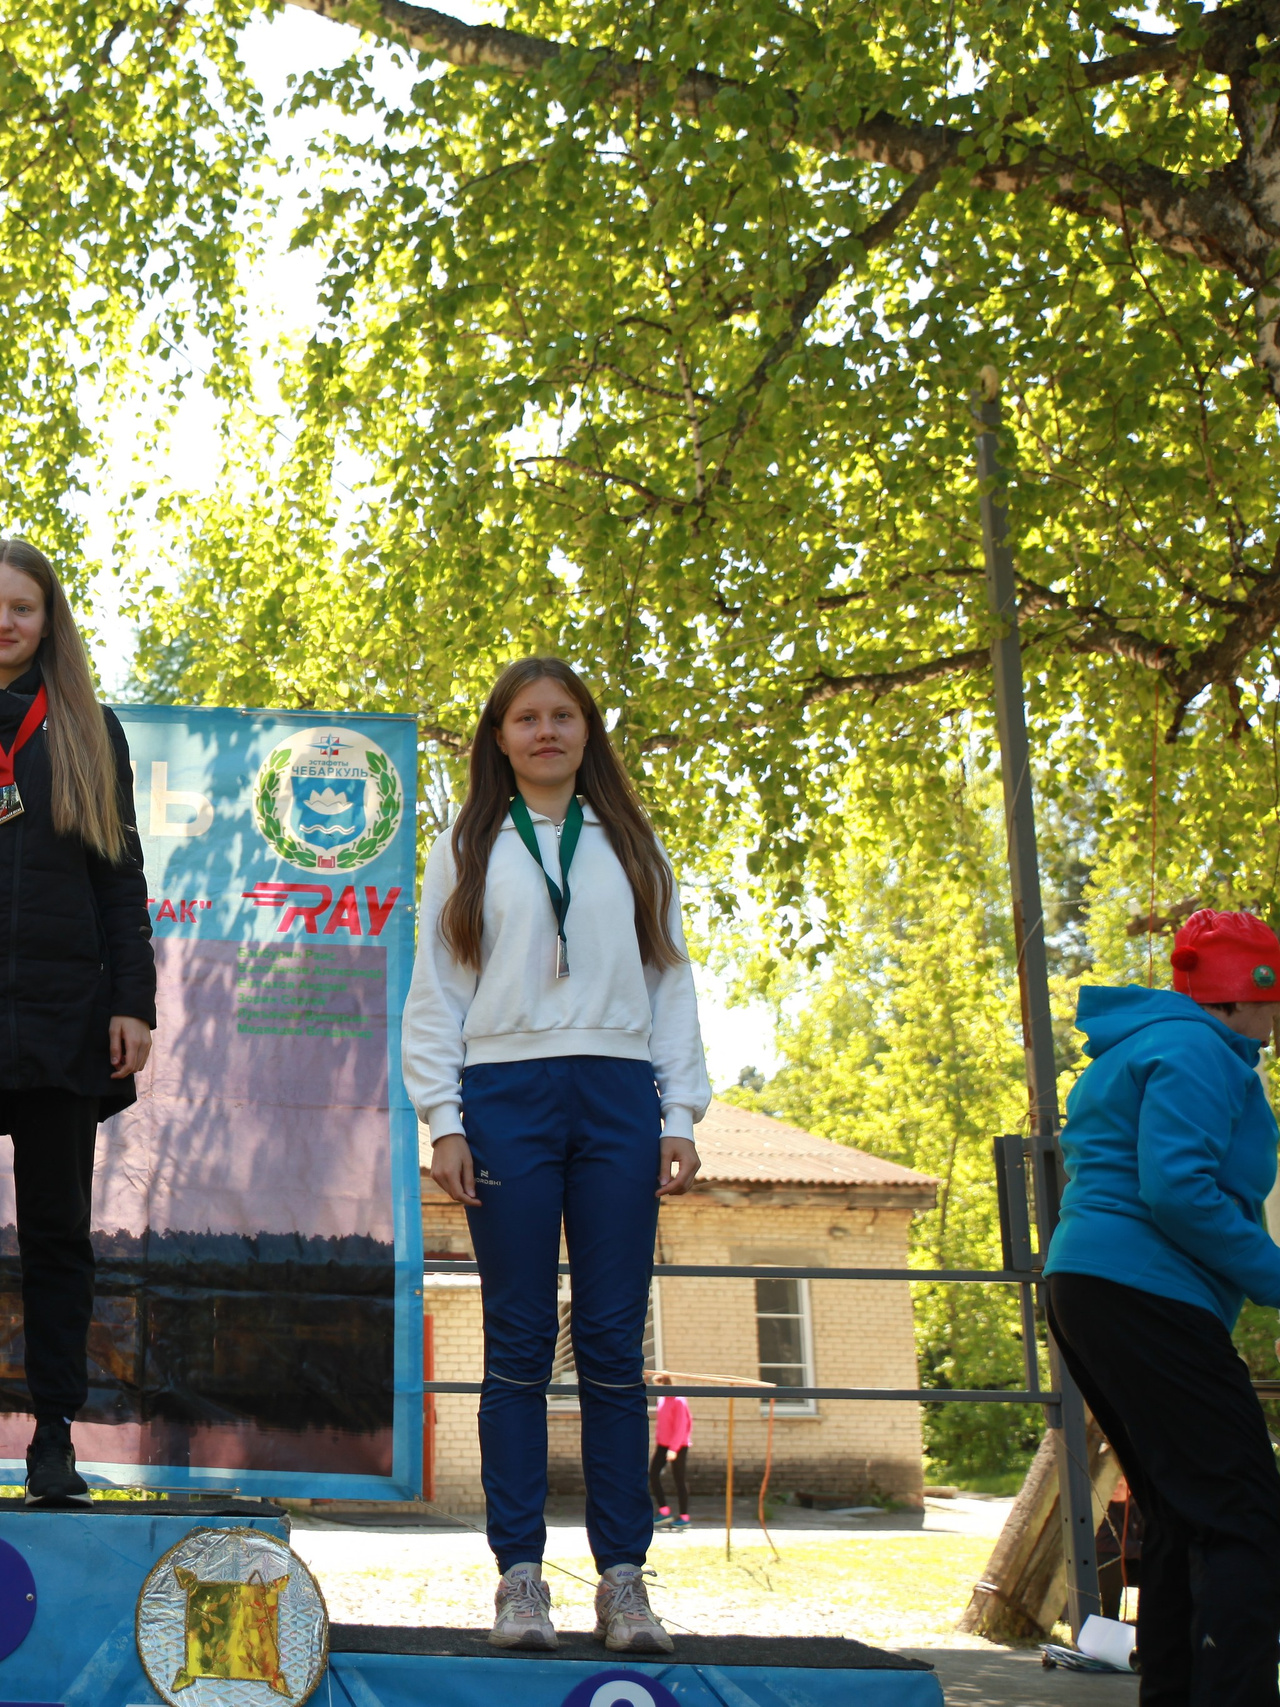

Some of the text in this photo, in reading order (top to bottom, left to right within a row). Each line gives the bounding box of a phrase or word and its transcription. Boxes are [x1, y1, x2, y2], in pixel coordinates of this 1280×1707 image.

[291, 766, 369, 777] ЧЕБАРКУЛЬ
[241, 882, 402, 936] RAY
[475, 1178, 501, 1186] ORDSKI
